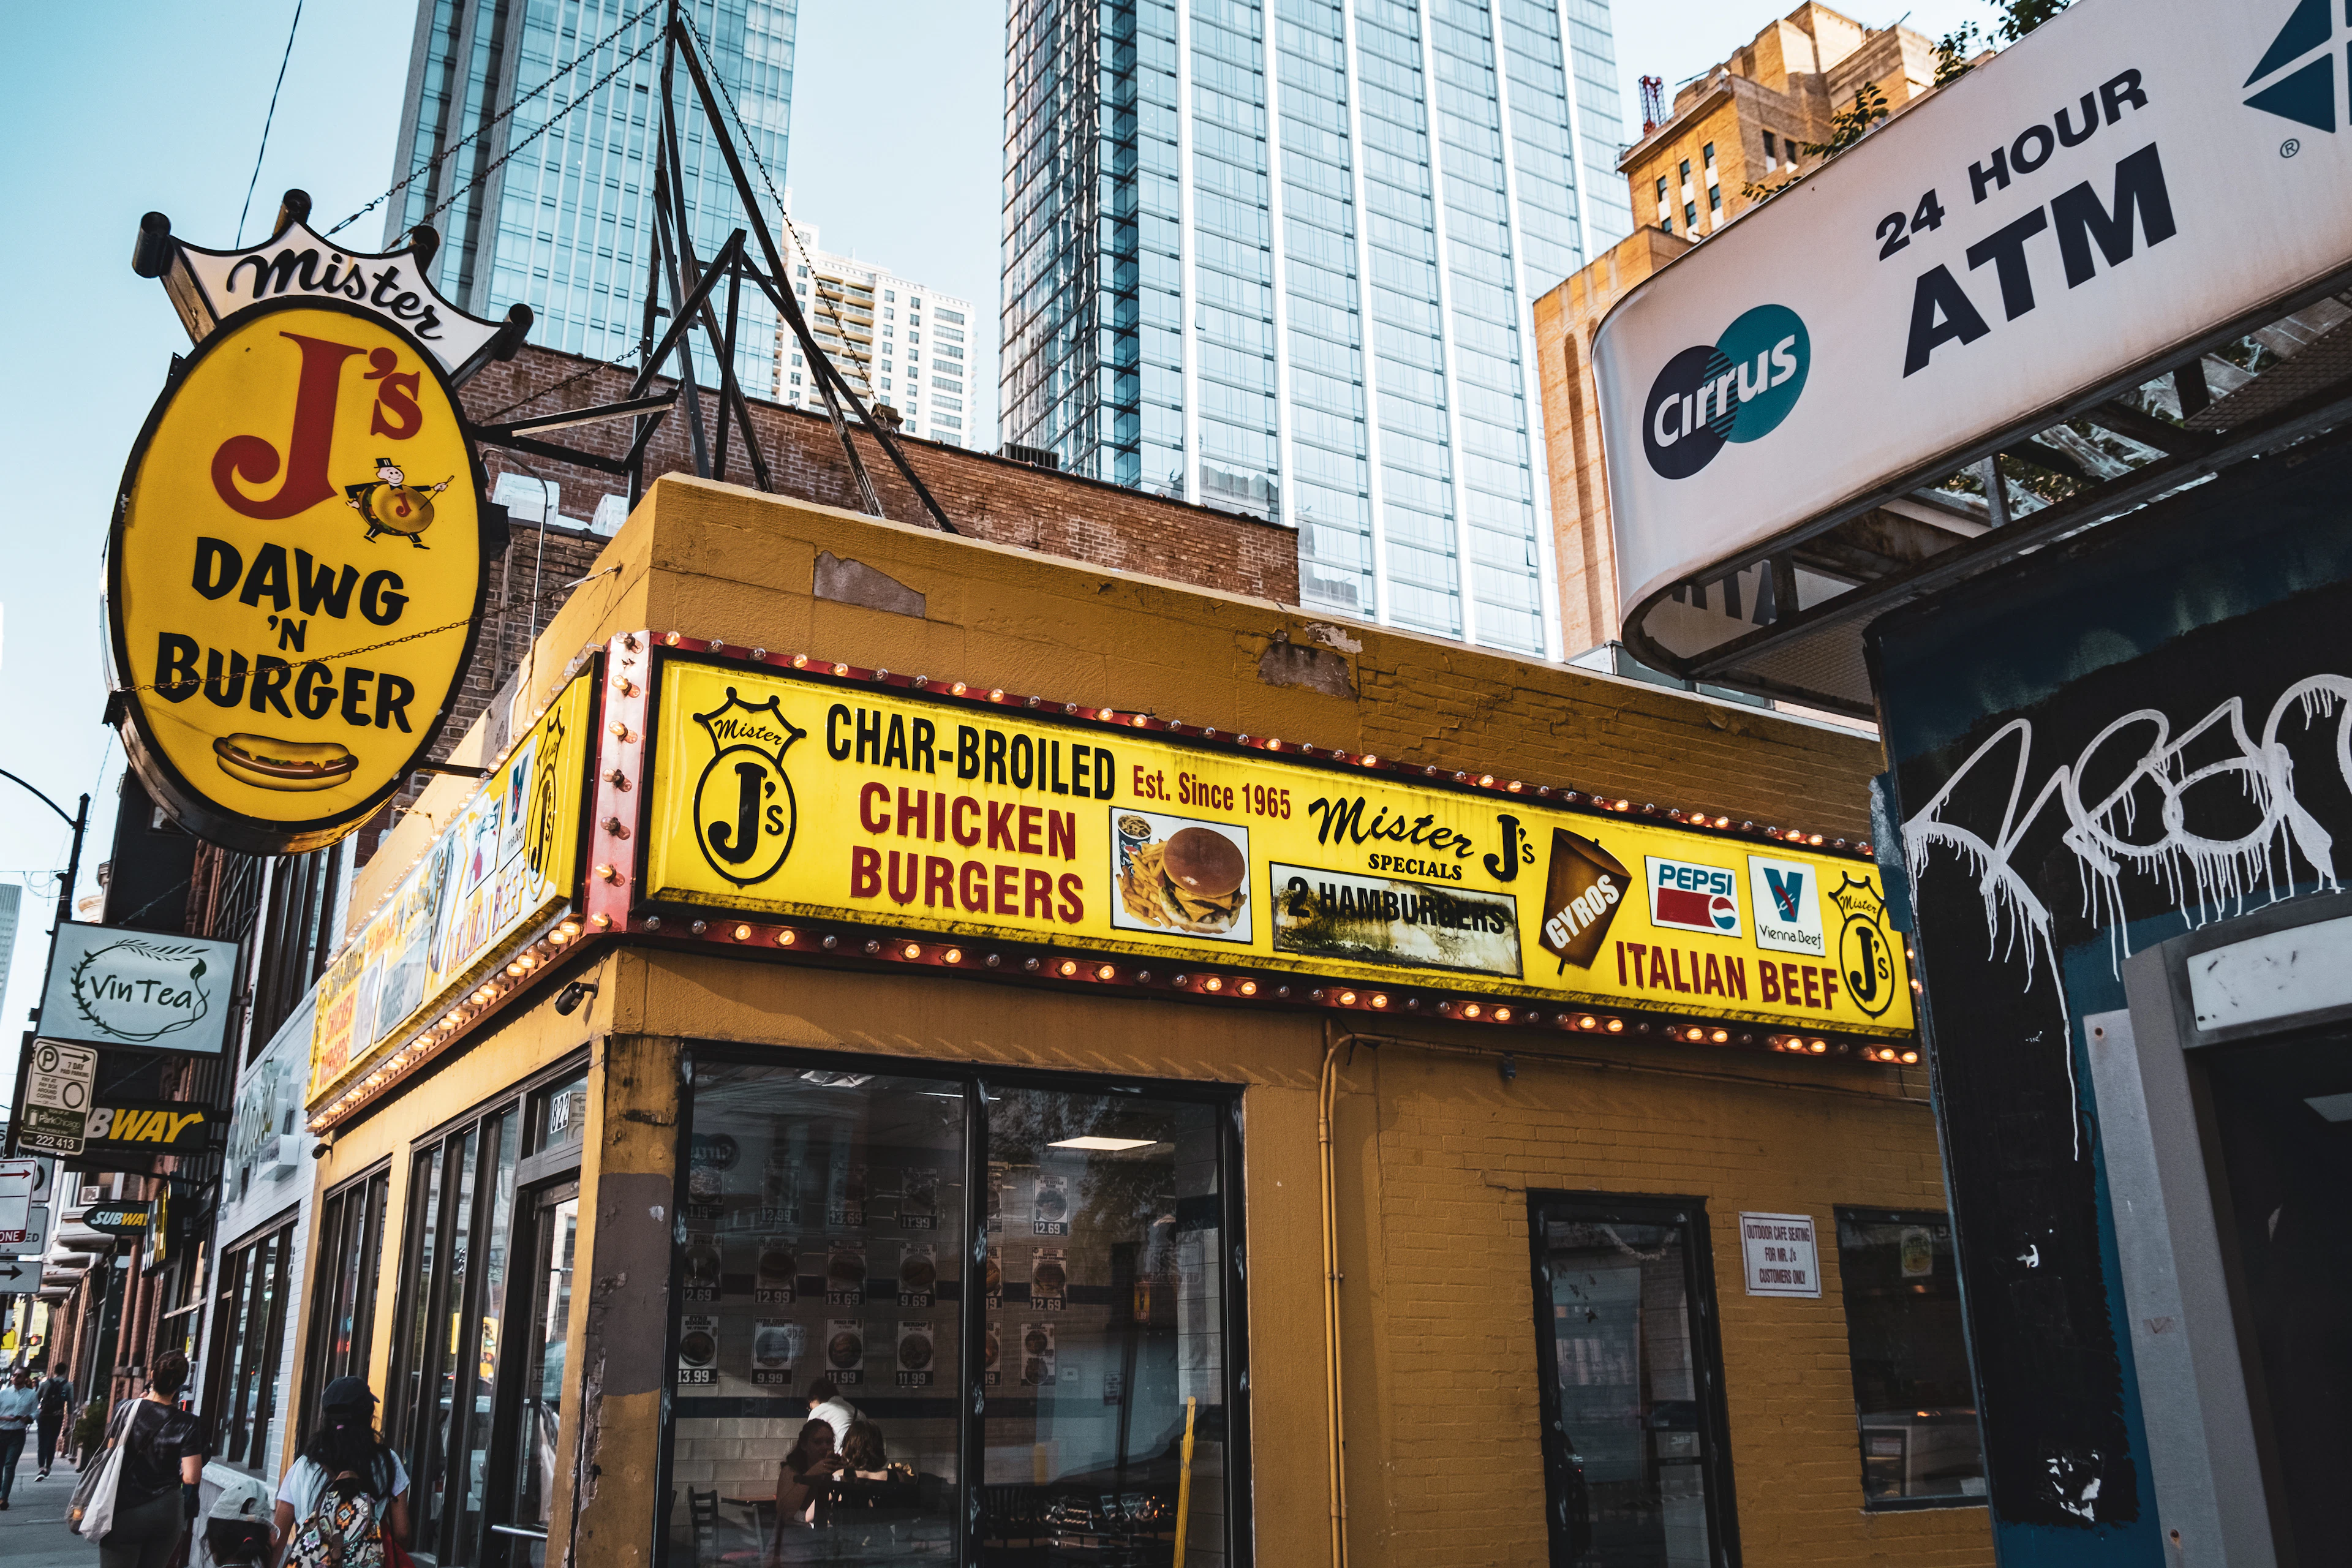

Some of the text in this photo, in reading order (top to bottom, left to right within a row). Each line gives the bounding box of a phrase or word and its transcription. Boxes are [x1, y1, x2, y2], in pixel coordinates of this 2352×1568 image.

[1874, 67, 2148, 262] 24 HOUR
[1903, 141, 2177, 378] ATM
[227, 249, 442, 340] Mister
[1654, 334, 1797, 448] Cirrus
[211, 331, 423, 519] J's
[192, 537, 409, 626] DAWG
[267, 615, 307, 652] 'N
[154, 632, 415, 733] BURGER
[714, 718, 782, 745] Mister
[827, 703, 1115, 800] CHAR-BROILED
[1133, 764, 1291, 820] Est. Since 1965
[707, 762, 784, 864] J's
[859, 782, 1076, 860] CHICKEN
[1308, 796, 1536, 882] Mister J's
[850, 845, 1085, 924] BURGERS
[1368, 854, 1462, 881] SPECIALS
[1658, 864, 1733, 896] PEPSI
[1287, 876, 1506, 935] 2 HAMBURGERS
[1545, 874, 1619, 949] GYROS
[1839, 895, 1879, 914] Mister
[1760, 924, 1822, 948] Vienna Beef
[1615, 941, 1838, 1010] ITALIAN BEEF
[1850, 926, 1890, 1001] J's
[86, 1107, 205, 1143] BWAY
[552, 1093, 569, 1132] 822
[36, 1134, 74, 1150] 222 413
[1035, 1223, 1060, 1234] 12.69
[1747, 1224, 1811, 1242] OUTDOOR CAFE SEATING
[1765, 1247, 1776, 1261] FOR
[1777, 1248, 1788, 1262] MR.
[1759, 1268, 1806, 1284] CUSTOMERS ONLY
[683, 1289, 712, 1302] 12.69
[757, 1291, 790, 1303] 12.99
[827, 1293, 860, 1305] 13.69
[901, 1295, 927, 1306] 9.69
[1032, 1298, 1061, 1310] 12.69
[677, 1370, 710, 1383] 13.99
[757, 1373, 783, 1384] 9.99
[827, 1372, 856, 1384] 11.99
[898, 1373, 926, 1385] 11.99
